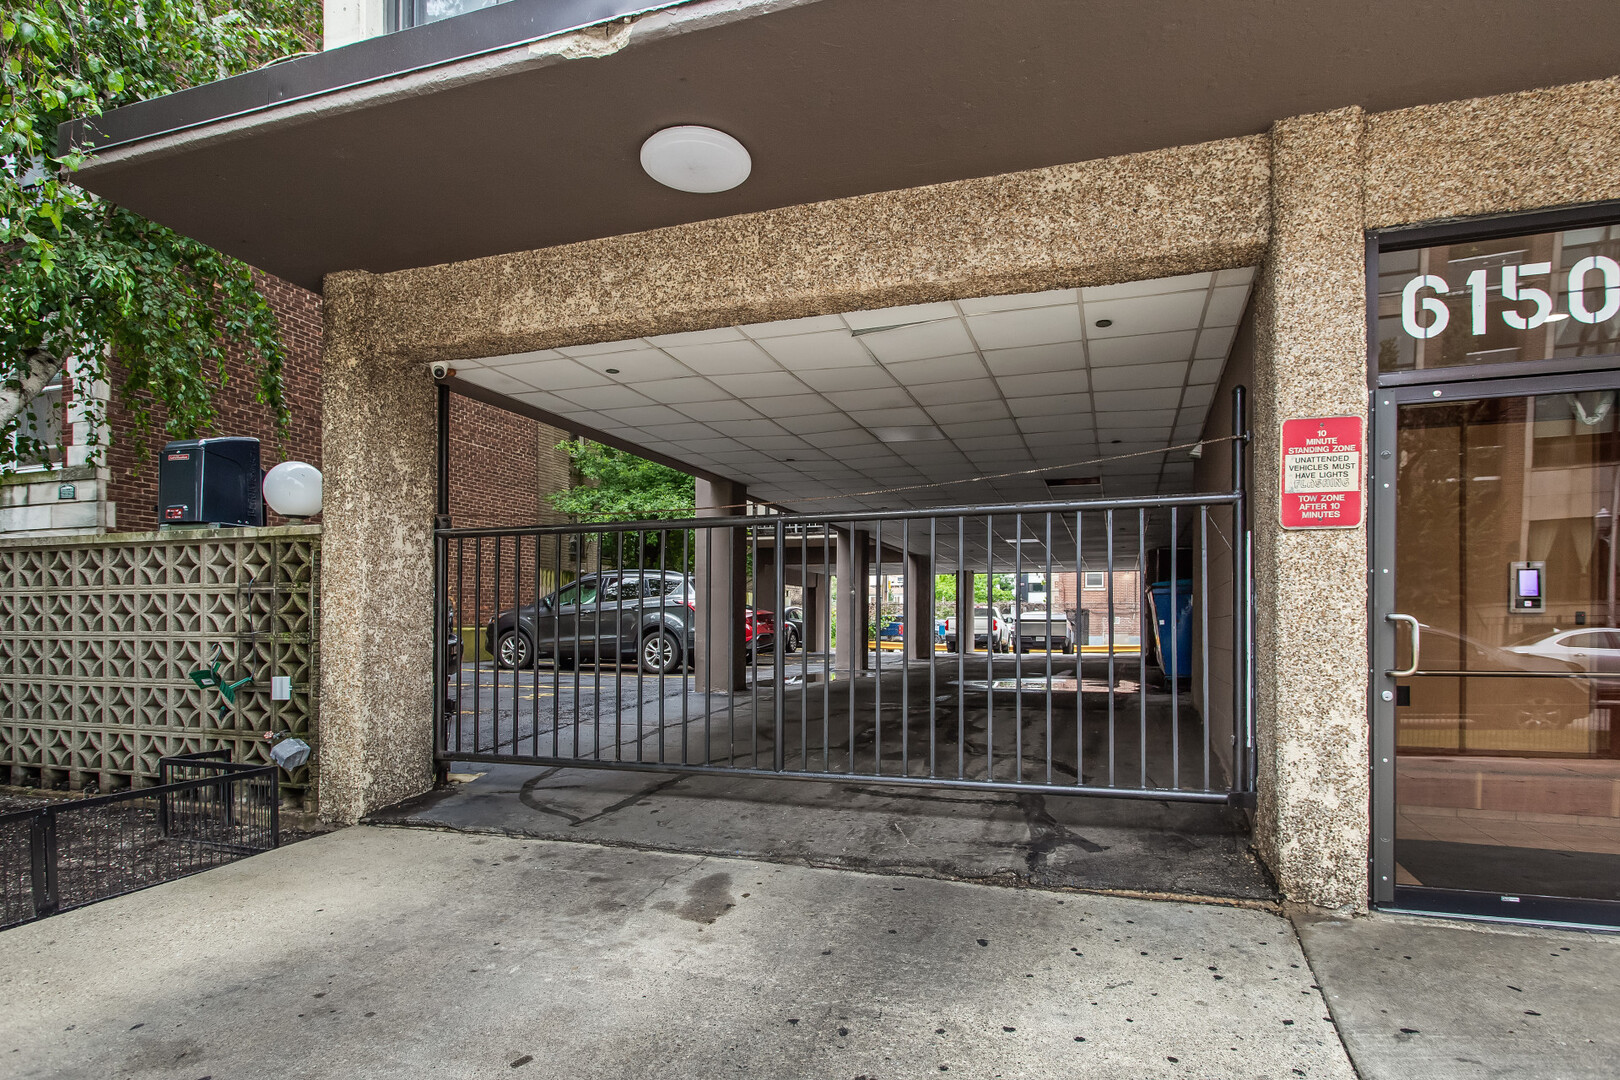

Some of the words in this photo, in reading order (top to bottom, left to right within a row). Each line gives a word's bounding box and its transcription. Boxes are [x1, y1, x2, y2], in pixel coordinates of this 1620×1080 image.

[1401, 255, 1620, 339] 6150
[1306, 437, 1338, 446] MINUTE
[1288, 445, 1329, 454] STANDING
[1332, 444, 1356, 452] ZONE
[1295, 455, 1349, 463] UNATTENDED
[1289, 463, 1328, 471] VEHICLES
[1298, 495, 1318, 503] TOW
[1320, 494, 1345, 502] ZONE
[1301, 511, 1341, 519] MINUTES
